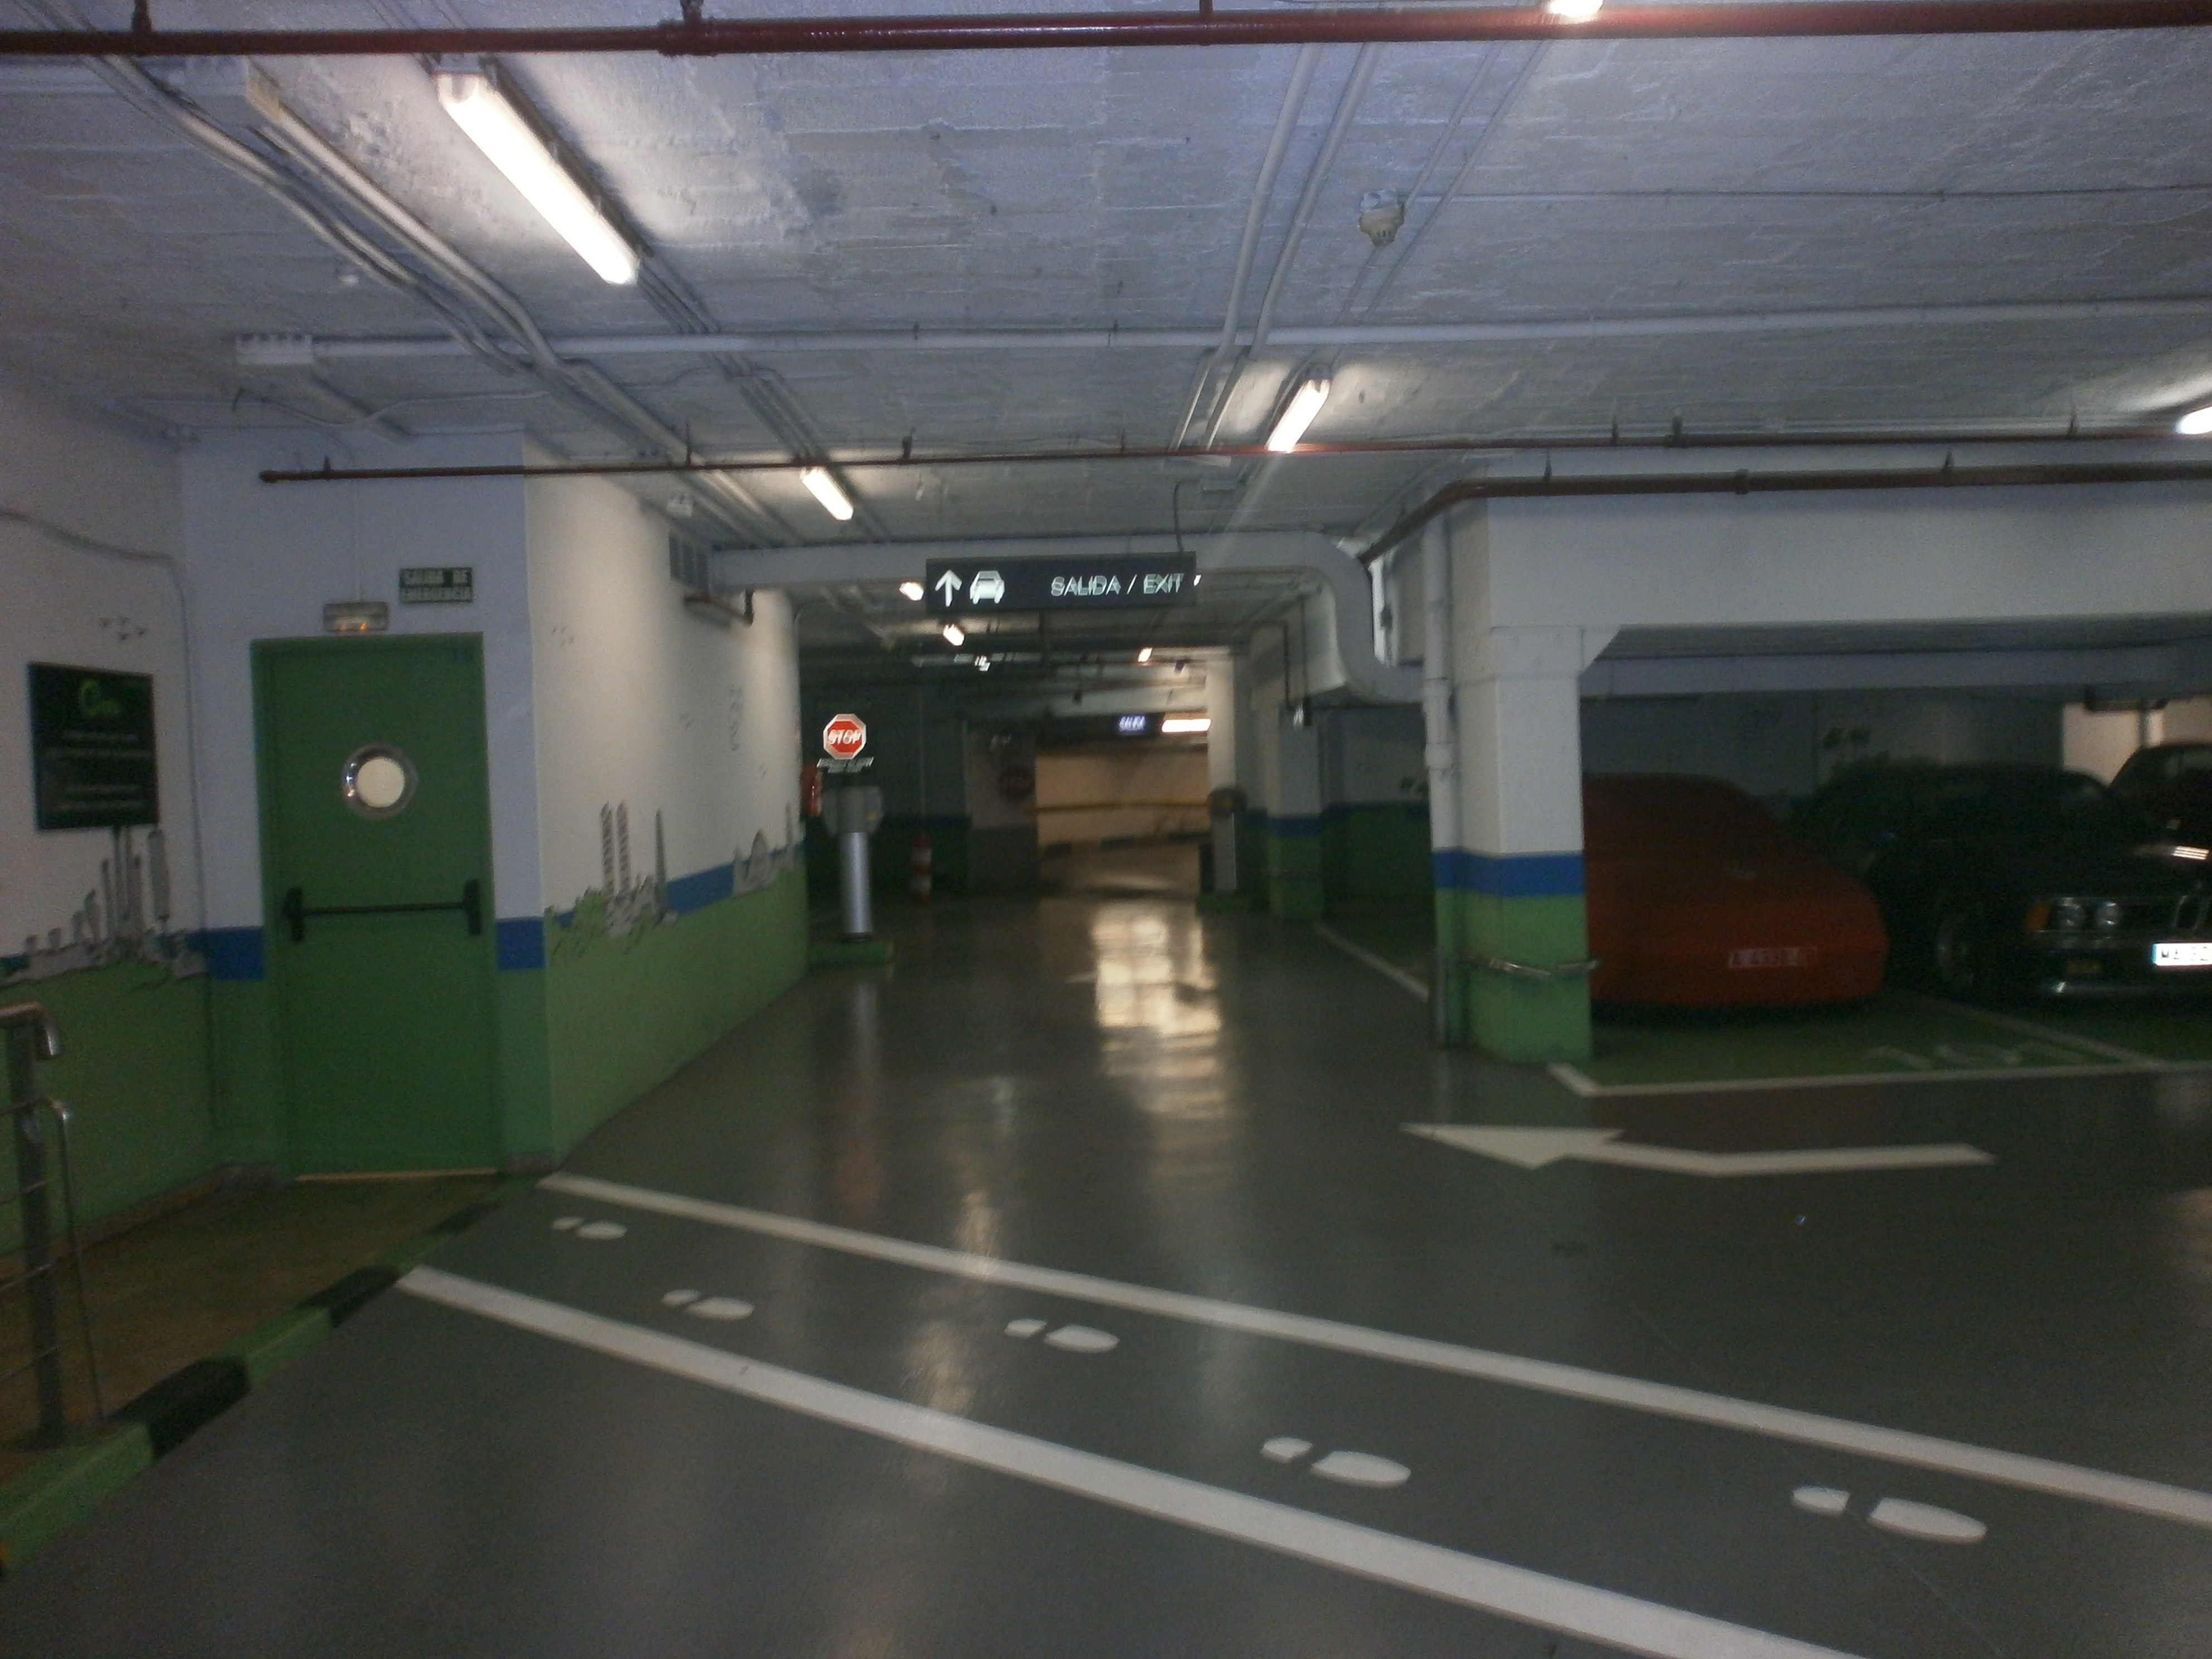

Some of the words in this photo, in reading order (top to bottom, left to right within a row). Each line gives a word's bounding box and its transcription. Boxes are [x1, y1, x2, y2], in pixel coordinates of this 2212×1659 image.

[403, 569, 443, 585] SALIDA
[452, 569, 468, 584] DE
[1051, 575, 1122, 596] SALIDA
[1127, 574, 1138, 594] /
[1143, 573, 1185, 594] EXIT
[828, 729, 862, 745] STOP
